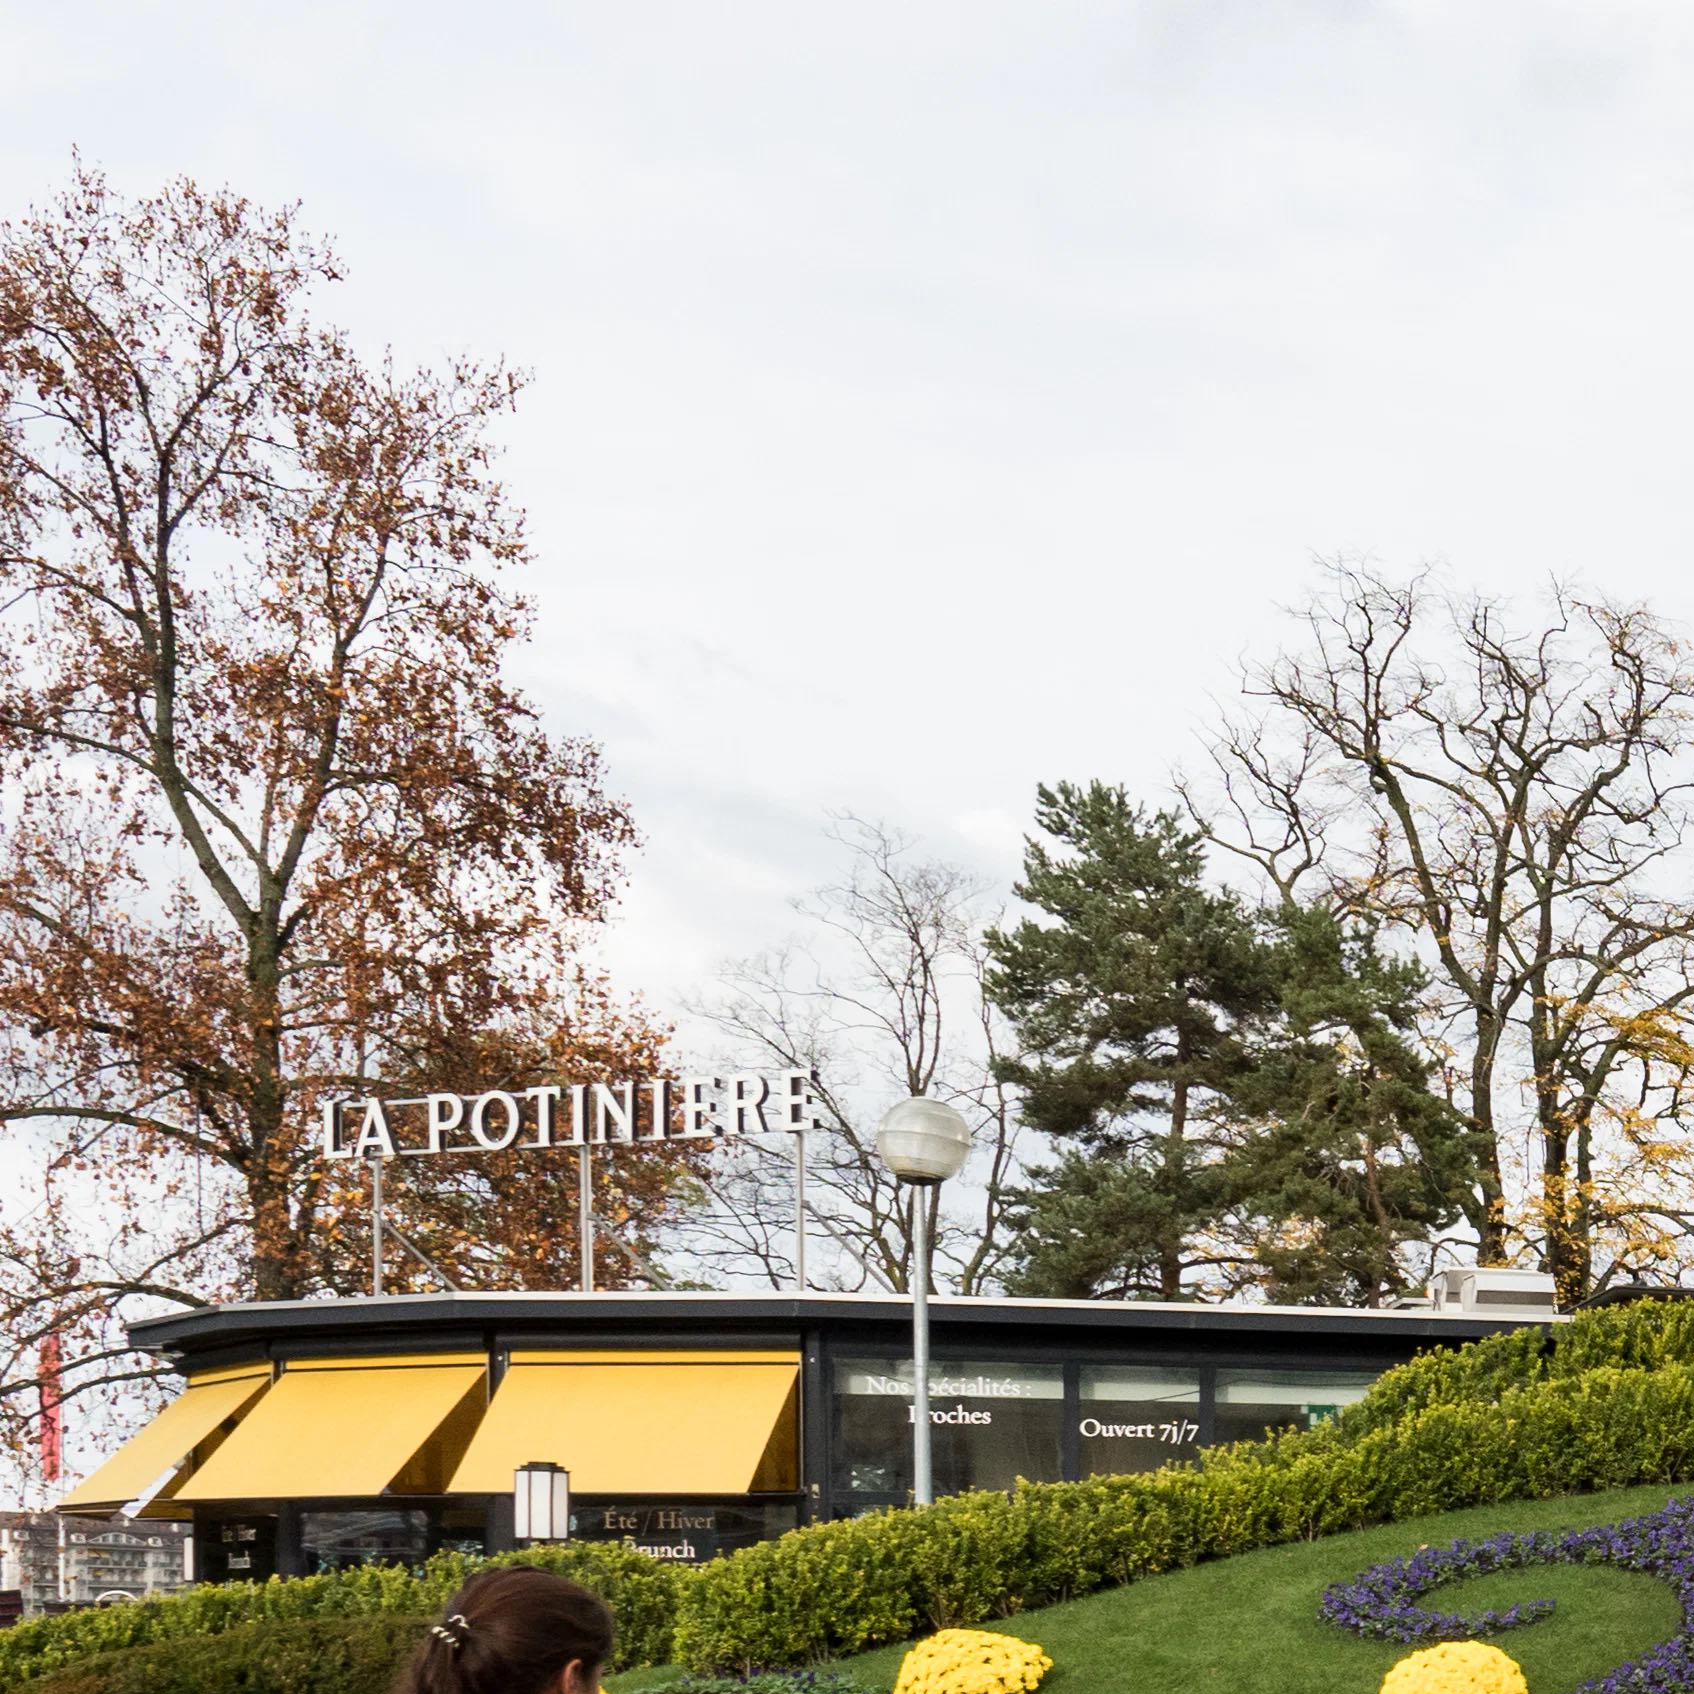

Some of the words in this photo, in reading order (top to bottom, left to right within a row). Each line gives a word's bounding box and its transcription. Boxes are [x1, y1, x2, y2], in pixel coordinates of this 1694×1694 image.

[323, 1097, 396, 1160] LA
[427, 1067, 820, 1154] POTINIERE
[864, 1375, 910, 1395] Nos
[928, 1375, 1021, 1400] pécialités
[1080, 1418, 1155, 1438] Ouvert
[1159, 1419, 1199, 1445] 7j/7
[604, 1505, 638, 1530] Été
[657, 1510, 716, 1530] Hiver
[624, 1538, 696, 1559] runch
